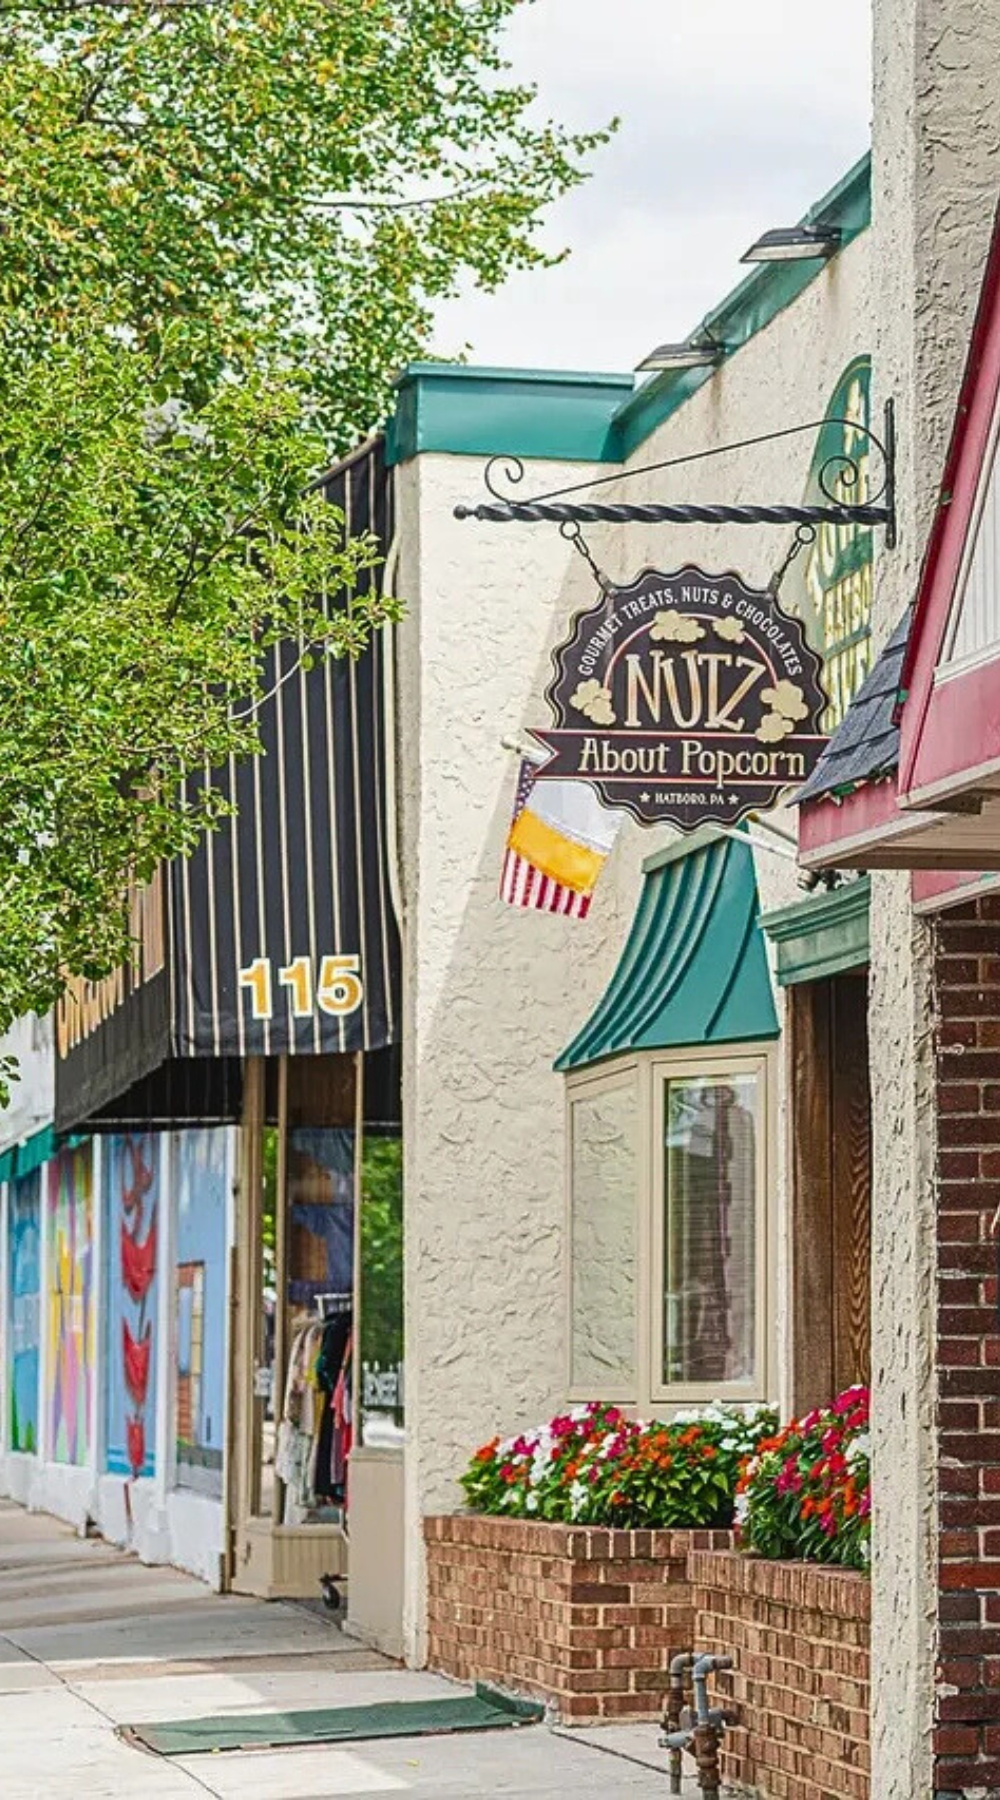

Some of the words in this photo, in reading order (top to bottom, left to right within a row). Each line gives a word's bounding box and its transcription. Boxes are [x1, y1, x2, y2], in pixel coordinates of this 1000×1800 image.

[578, 614, 625, 676] GOURMET
[681, 586, 719, 605] NUTS
[721, 593, 733, 608] &
[735, 599, 802, 677] CHOCOLATES
[624, 650, 766, 731] NUTZ
[577, 738, 670, 774] About
[681, 739, 804, 788] Popcorn
[710, 794, 725, 806] PA
[240, 955, 363, 1019] 115
